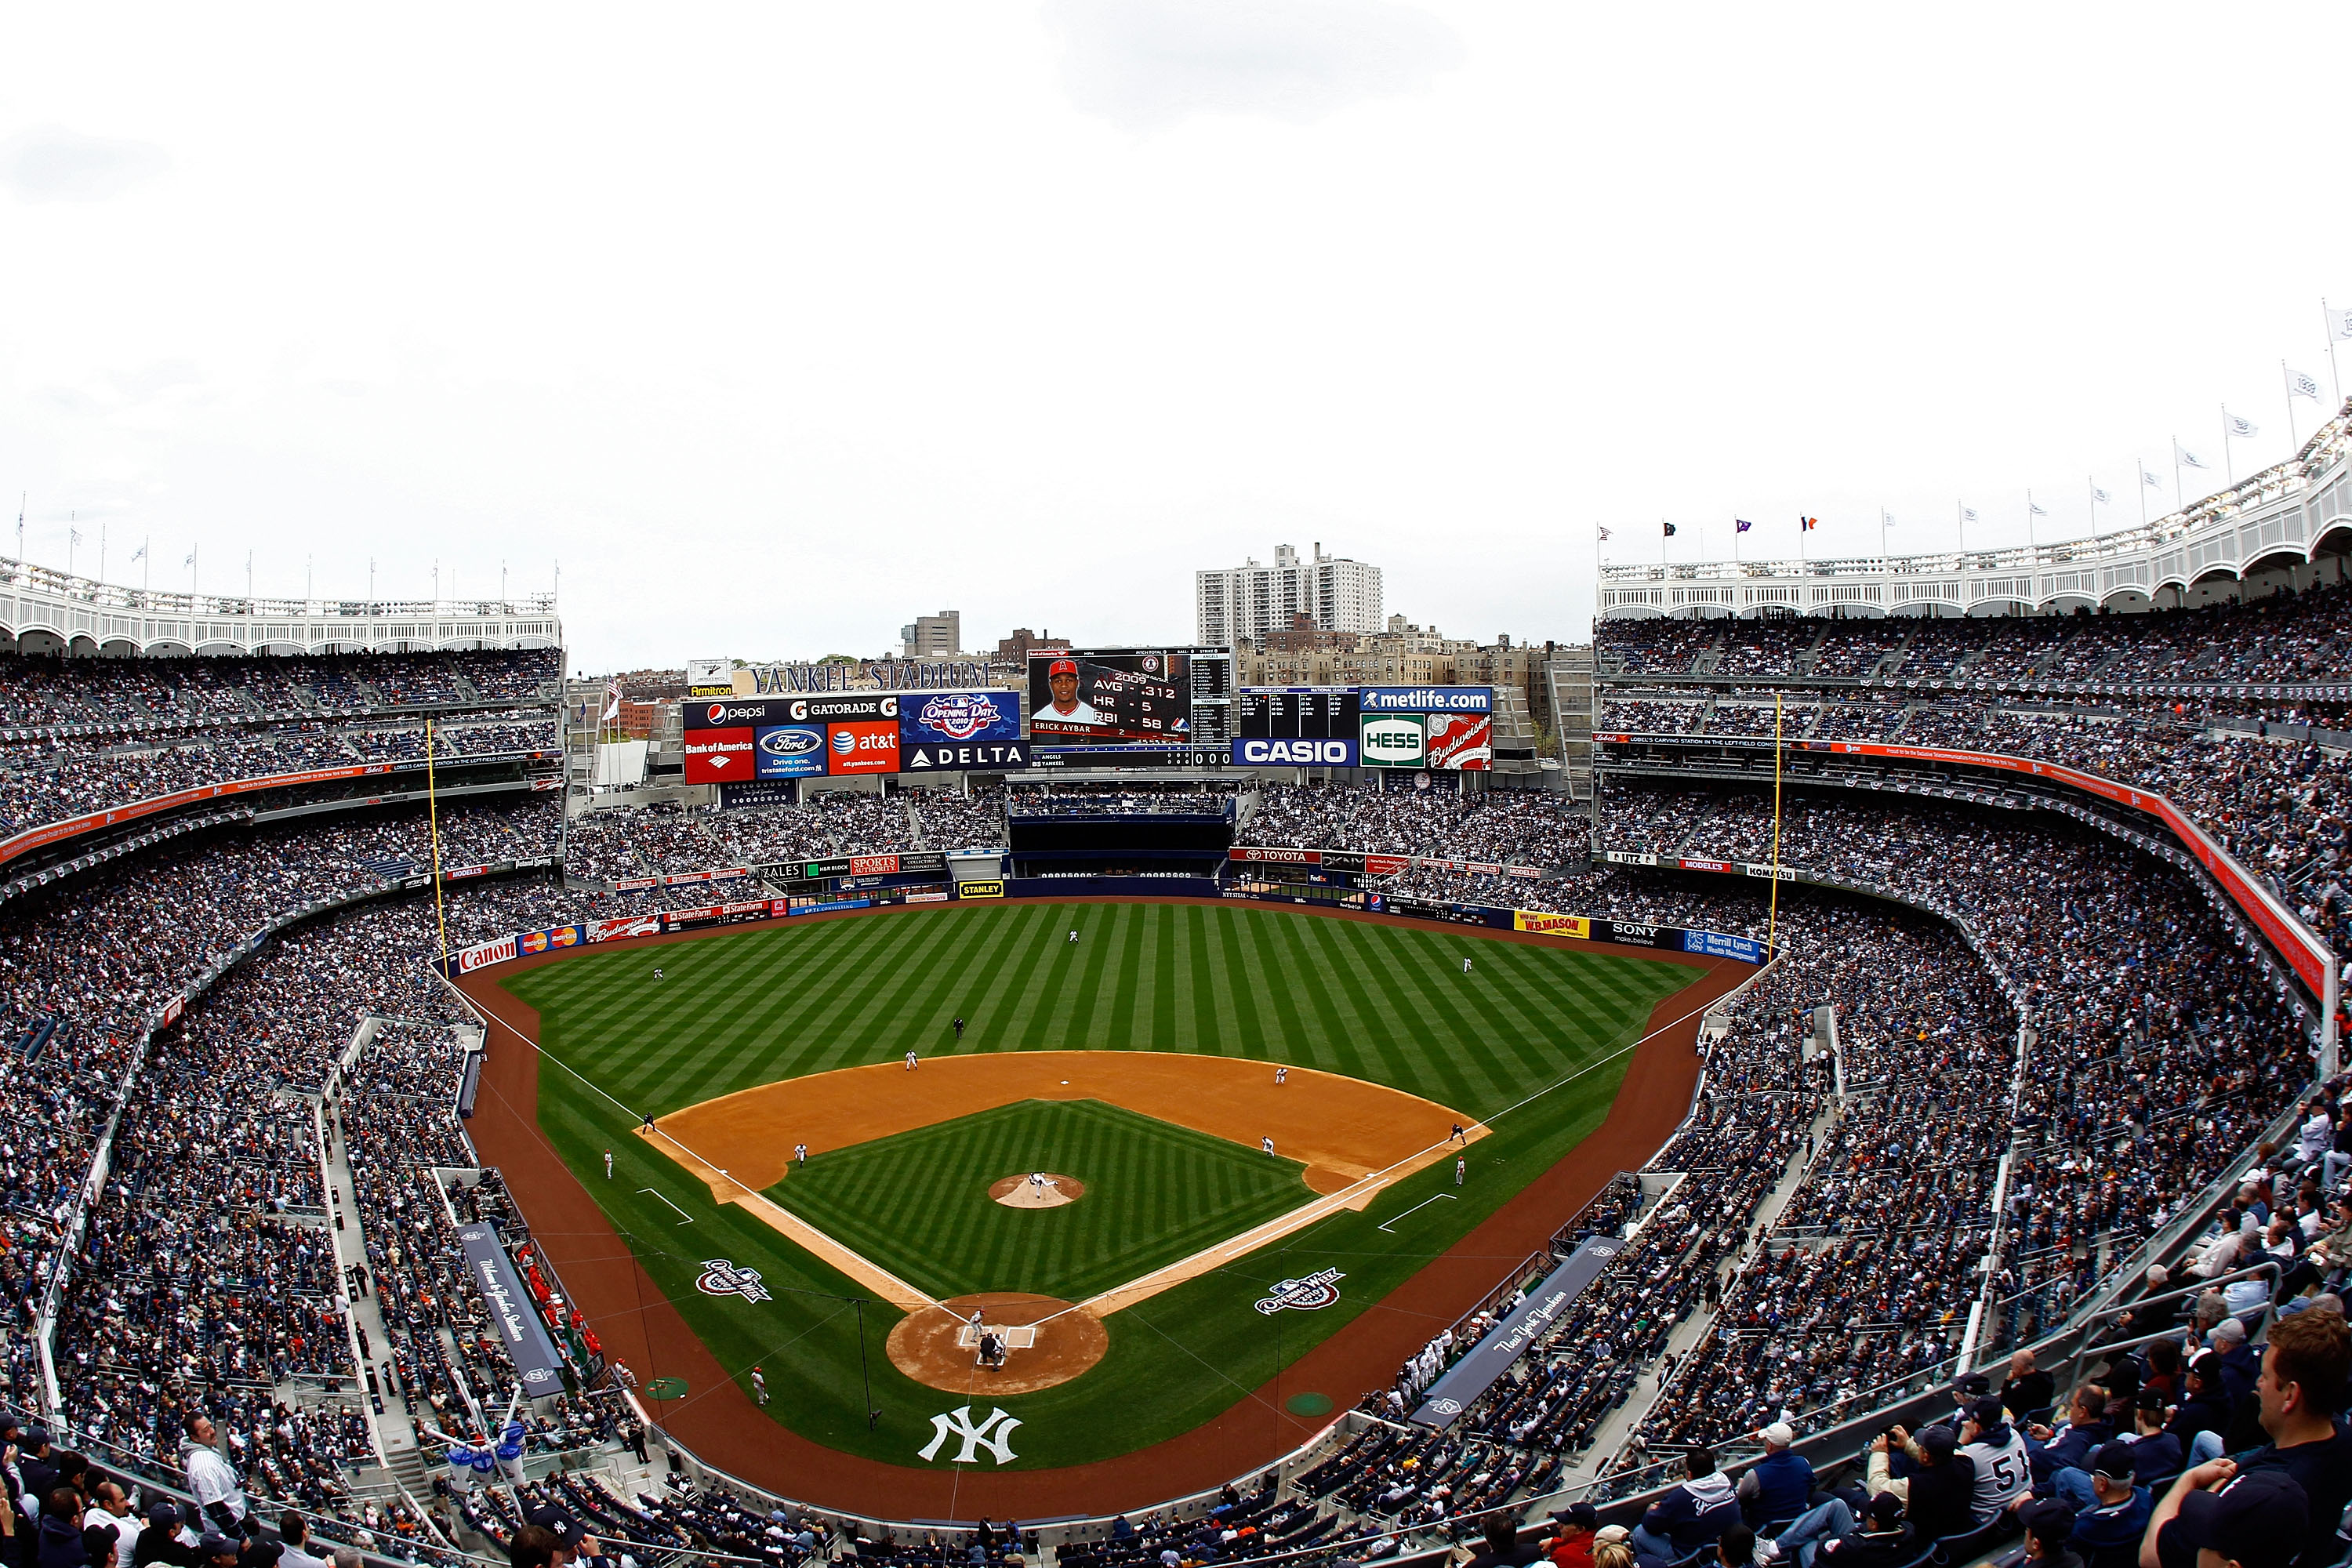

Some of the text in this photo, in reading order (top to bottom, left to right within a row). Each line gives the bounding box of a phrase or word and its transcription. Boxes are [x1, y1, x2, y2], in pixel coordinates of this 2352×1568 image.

[750, 663, 990, 694] YANKEE STADIUM
[1114, 673, 1147, 684] 2009
[691, 686, 732, 696] Armitron
[1094, 680, 1175, 699] AVG .312
[1094, 695, 1151, 712] HR 5
[1380, 689, 1486, 709] metlife.com
[728, 705, 765, 720] pepsi
[811, 702, 877, 716] GATORADE
[927, 705, 994, 719] OPENING DAY
[1094, 710, 1162, 729] RBI 58
[1035, 722, 1059, 731] ERICK
[1062, 724, 1091, 733] AYBAR
[685, 741, 753, 754] Bank of America
[775, 735, 808, 750] Ford
[859, 732, 896, 750] at&t
[1367, 732, 1419, 749] HESS
[1427, 715, 1491, 768] Budweiser
[938, 746, 1022, 764] DELTA
[1196, 753, 1230, 764] 0 0 0
[1244, 740, 1347, 763] CASIO
[1452, 753, 1475, 766] American
[534, 856, 552, 867] Spring
[853, 856, 895, 869] SPORTS
[1262, 851, 1306, 862] TOYOTA
[1422, 859, 1450, 868] MODELL'S
[1622, 854, 1641, 864] UTZ
[452, 867, 482, 878] MODELL'S
[763, 865, 799, 878] ZALES
[1685, 860, 1723, 871] MODELL'S
[1310, 874, 1327, 883] FedEx
[964, 885, 999, 894] STANLEY
[595, 916, 648, 942] Budweiser
[1613, 924, 1658, 937] SONY
[1707, 935, 1732, 948] Merrill
[1733, 939, 1752, 953] Lynch
[461, 941, 515, 970] Canon
[1707, 945, 1725, 955] Wealth
[1725, 949, 1756, 963] Management
[479, 1258, 498, 1285] Welcome
[1259, 1272, 1337, 1310] OPENING WEEK
[1301, 1289, 1319, 1301] 2010
[485, 1288, 515, 1314] Yankee
[503, 1313, 524, 1342] Stadium
[1493, 1290, 1567, 1353] New York Yankees
[917, 1405, 1024, 1465] NY
[1991, 1449, 2031, 1494] 51
[554, 1521, 568, 1534] NY
